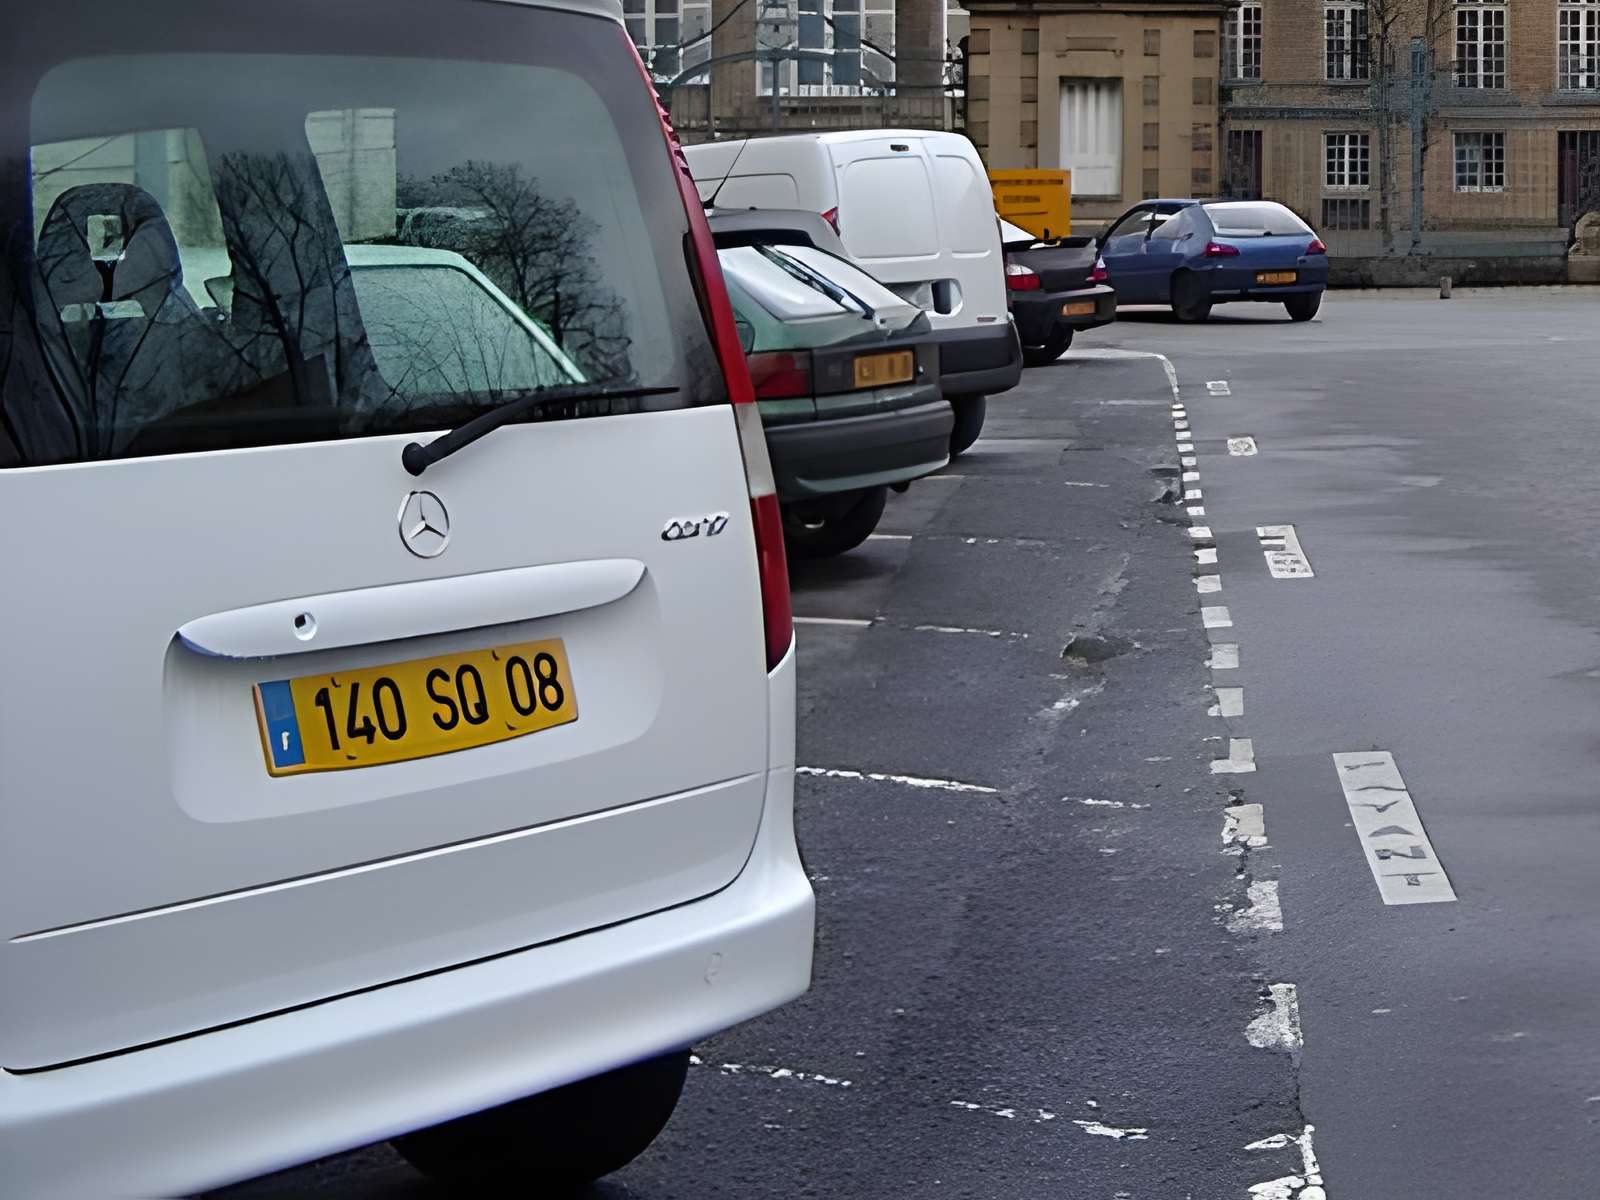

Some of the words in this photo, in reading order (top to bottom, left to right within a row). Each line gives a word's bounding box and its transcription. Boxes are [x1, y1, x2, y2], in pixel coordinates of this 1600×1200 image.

[314, 677, 407, 751] 140
[425, 663, 490, 731] SQ
[505, 652, 565, 716] 08
